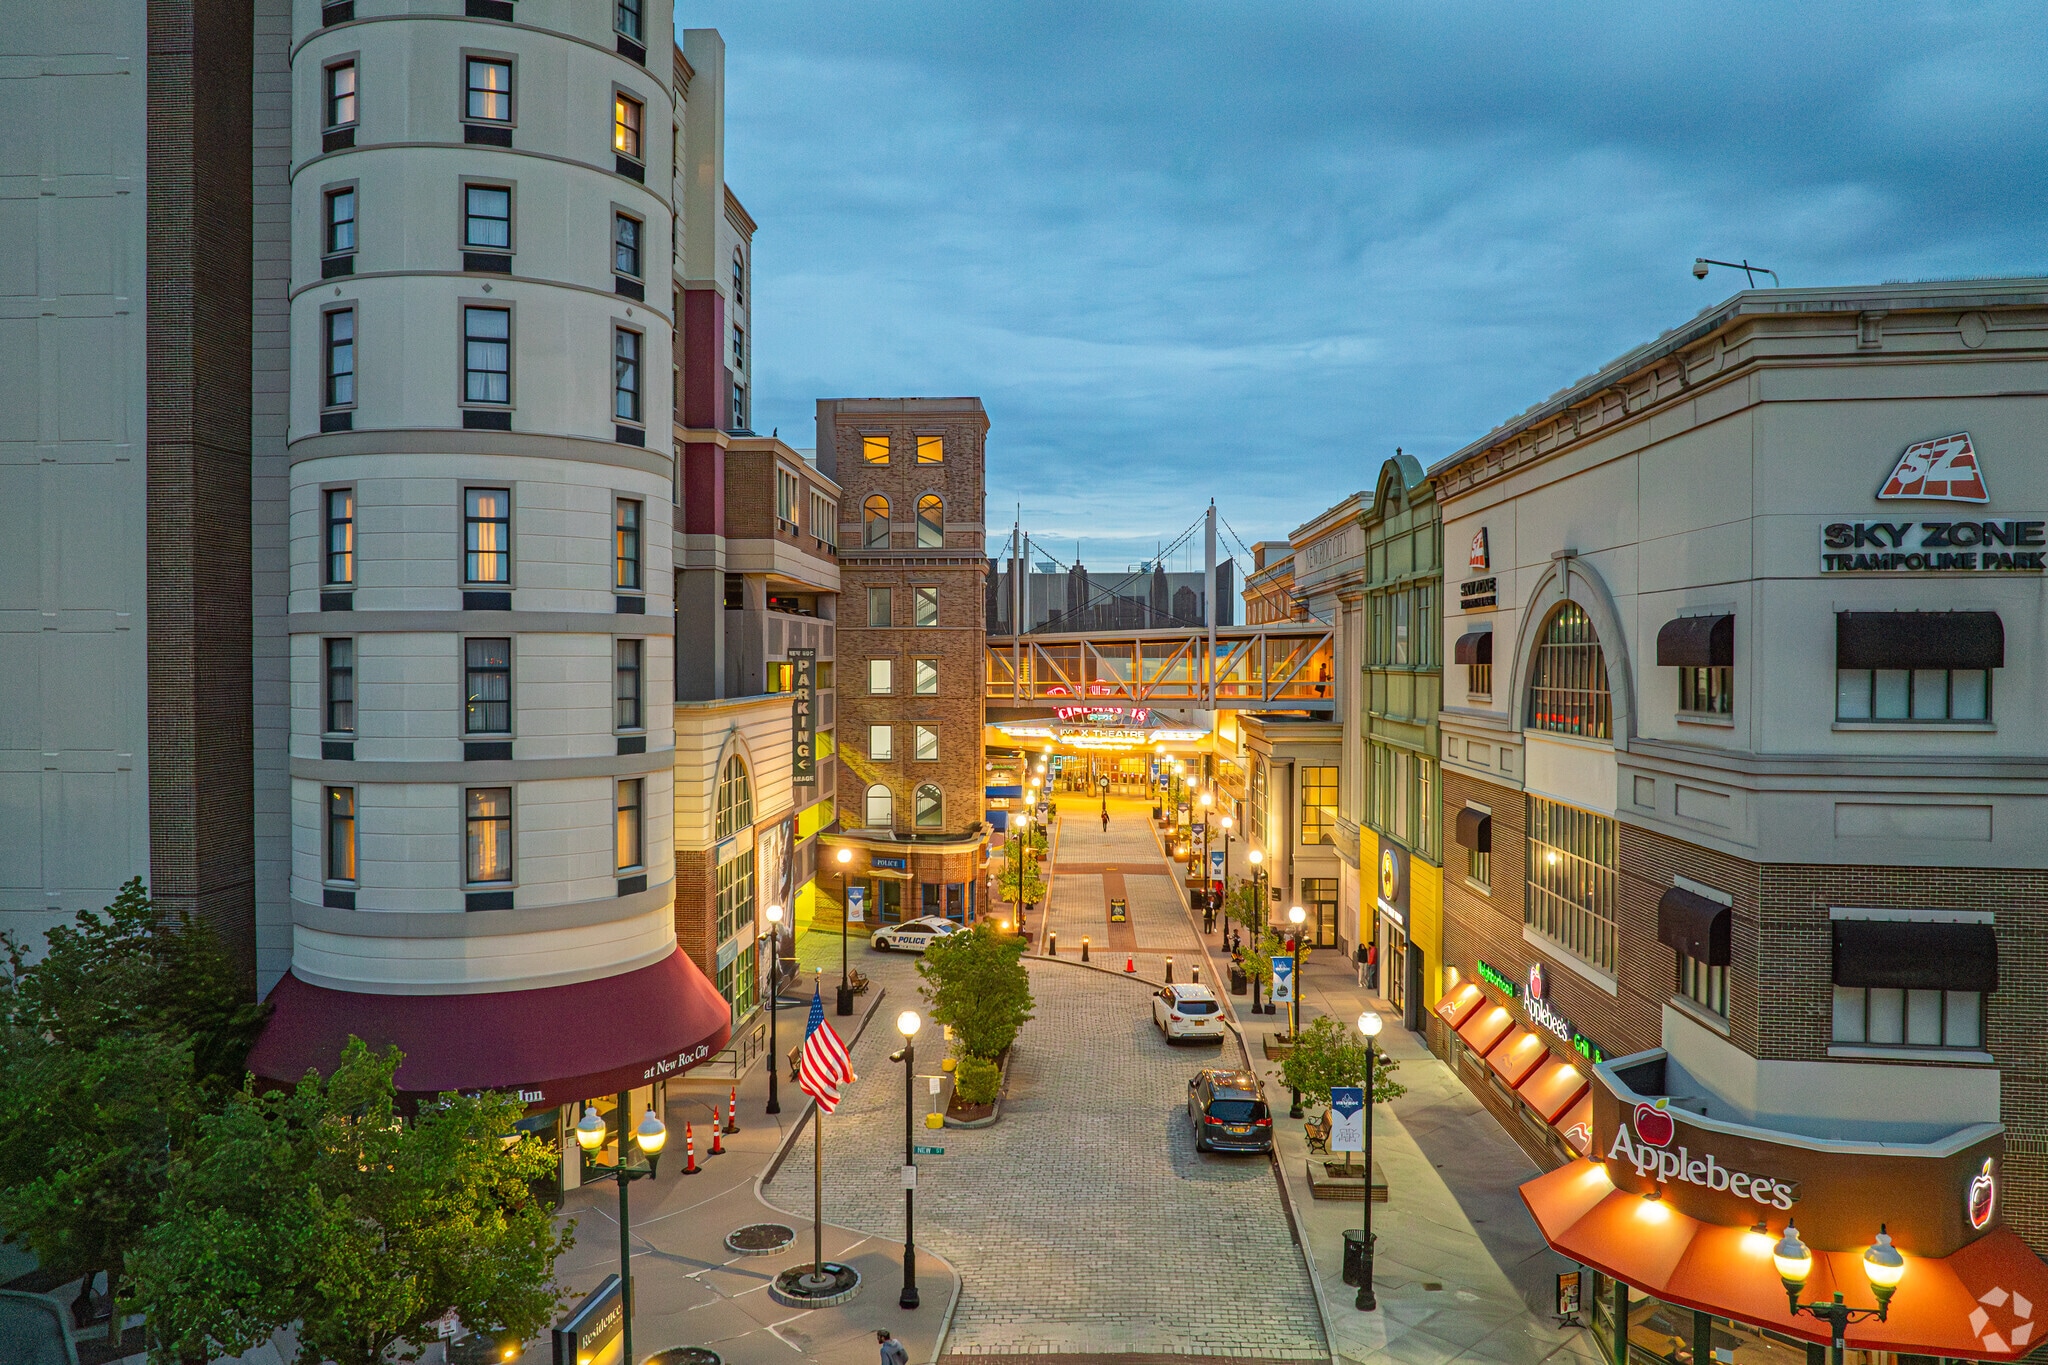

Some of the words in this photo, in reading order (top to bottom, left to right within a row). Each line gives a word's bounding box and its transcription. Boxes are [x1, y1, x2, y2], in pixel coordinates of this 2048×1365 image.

[1897, 440, 1975, 484] SZ
[1824, 522, 1913, 549] SKY
[1921, 521, 2046, 548] ZONE
[1823, 552, 1977, 571] TRAMPOLINE
[1983, 551, 2047, 571] PARK
[797, 660, 810, 758] PARKING
[1130, 707, 1147, 722] 18
[1060, 728, 1089, 737] IMAX
[1093, 729, 1145, 739] THEATRE
[792, 775, 814, 783] ARAGE
[877, 859, 898, 867] POLICE
[898, 936, 926, 945] POLICE
[1523, 984, 1568, 1042] Applebee's
[644, 1067, 656, 1080] at
[656, 1058, 678, 1076] New
[678, 1052, 694, 1068] Roc
[695, 1044, 710, 1060] City
[1607, 1122, 1793, 1211] Applebee's
[582, 1304, 622, 1350] Residence
